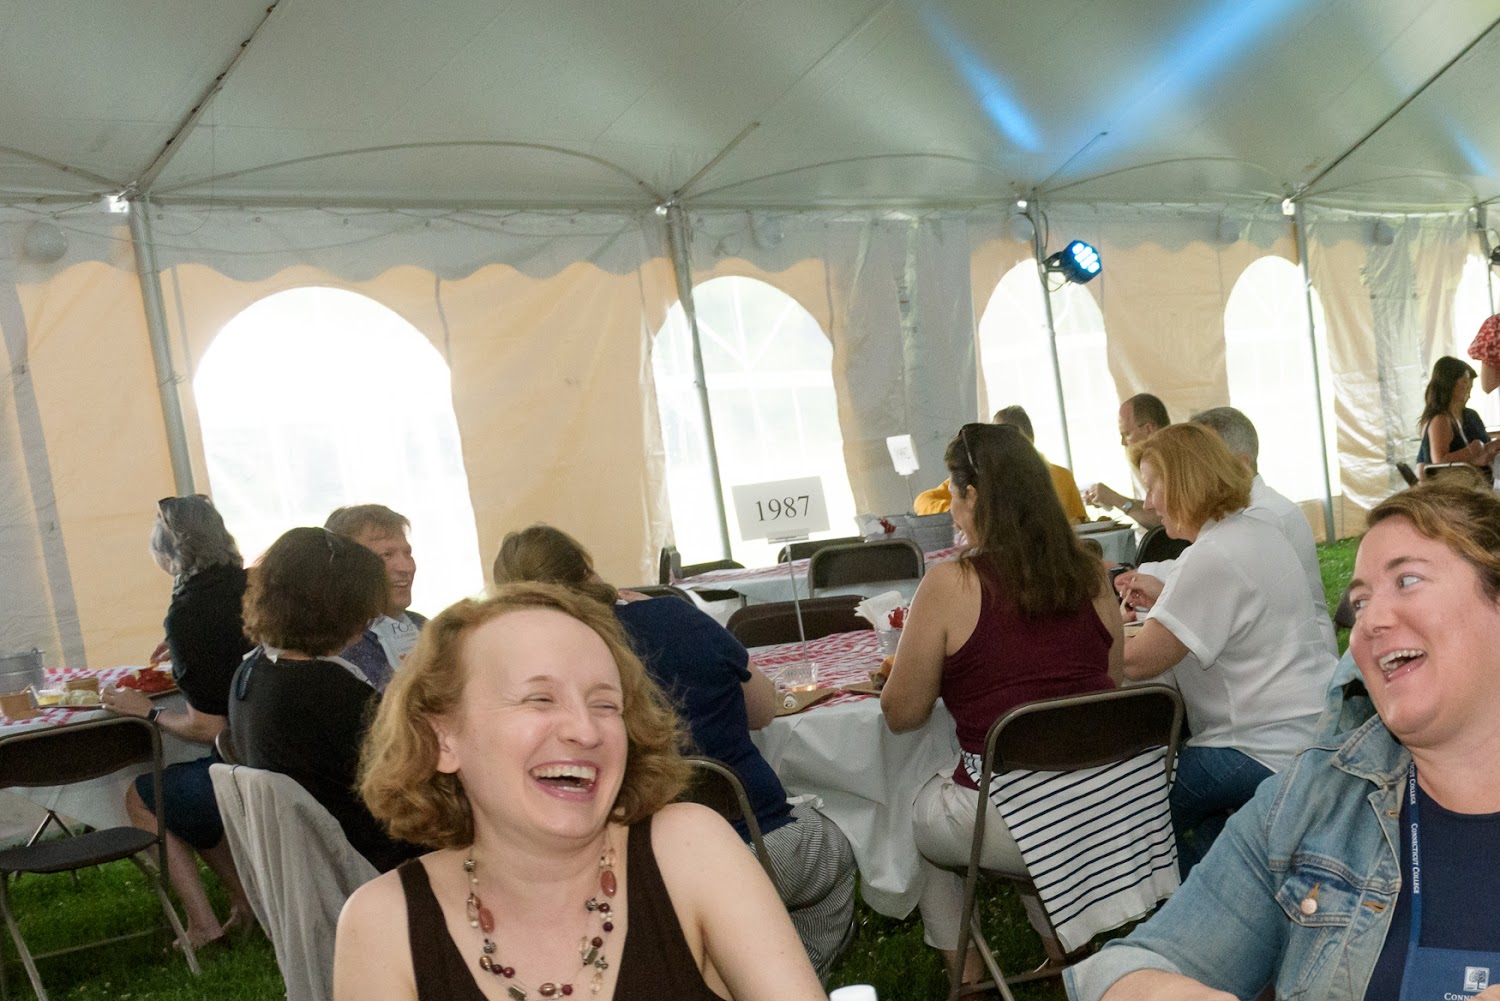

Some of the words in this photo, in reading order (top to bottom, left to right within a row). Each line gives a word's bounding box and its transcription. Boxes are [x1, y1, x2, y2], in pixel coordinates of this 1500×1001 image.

[755, 495, 809, 522] 1987
[1411, 823, 1420, 865] CONNECTICUT
[1413, 866, 1421, 894] COLLEGE
